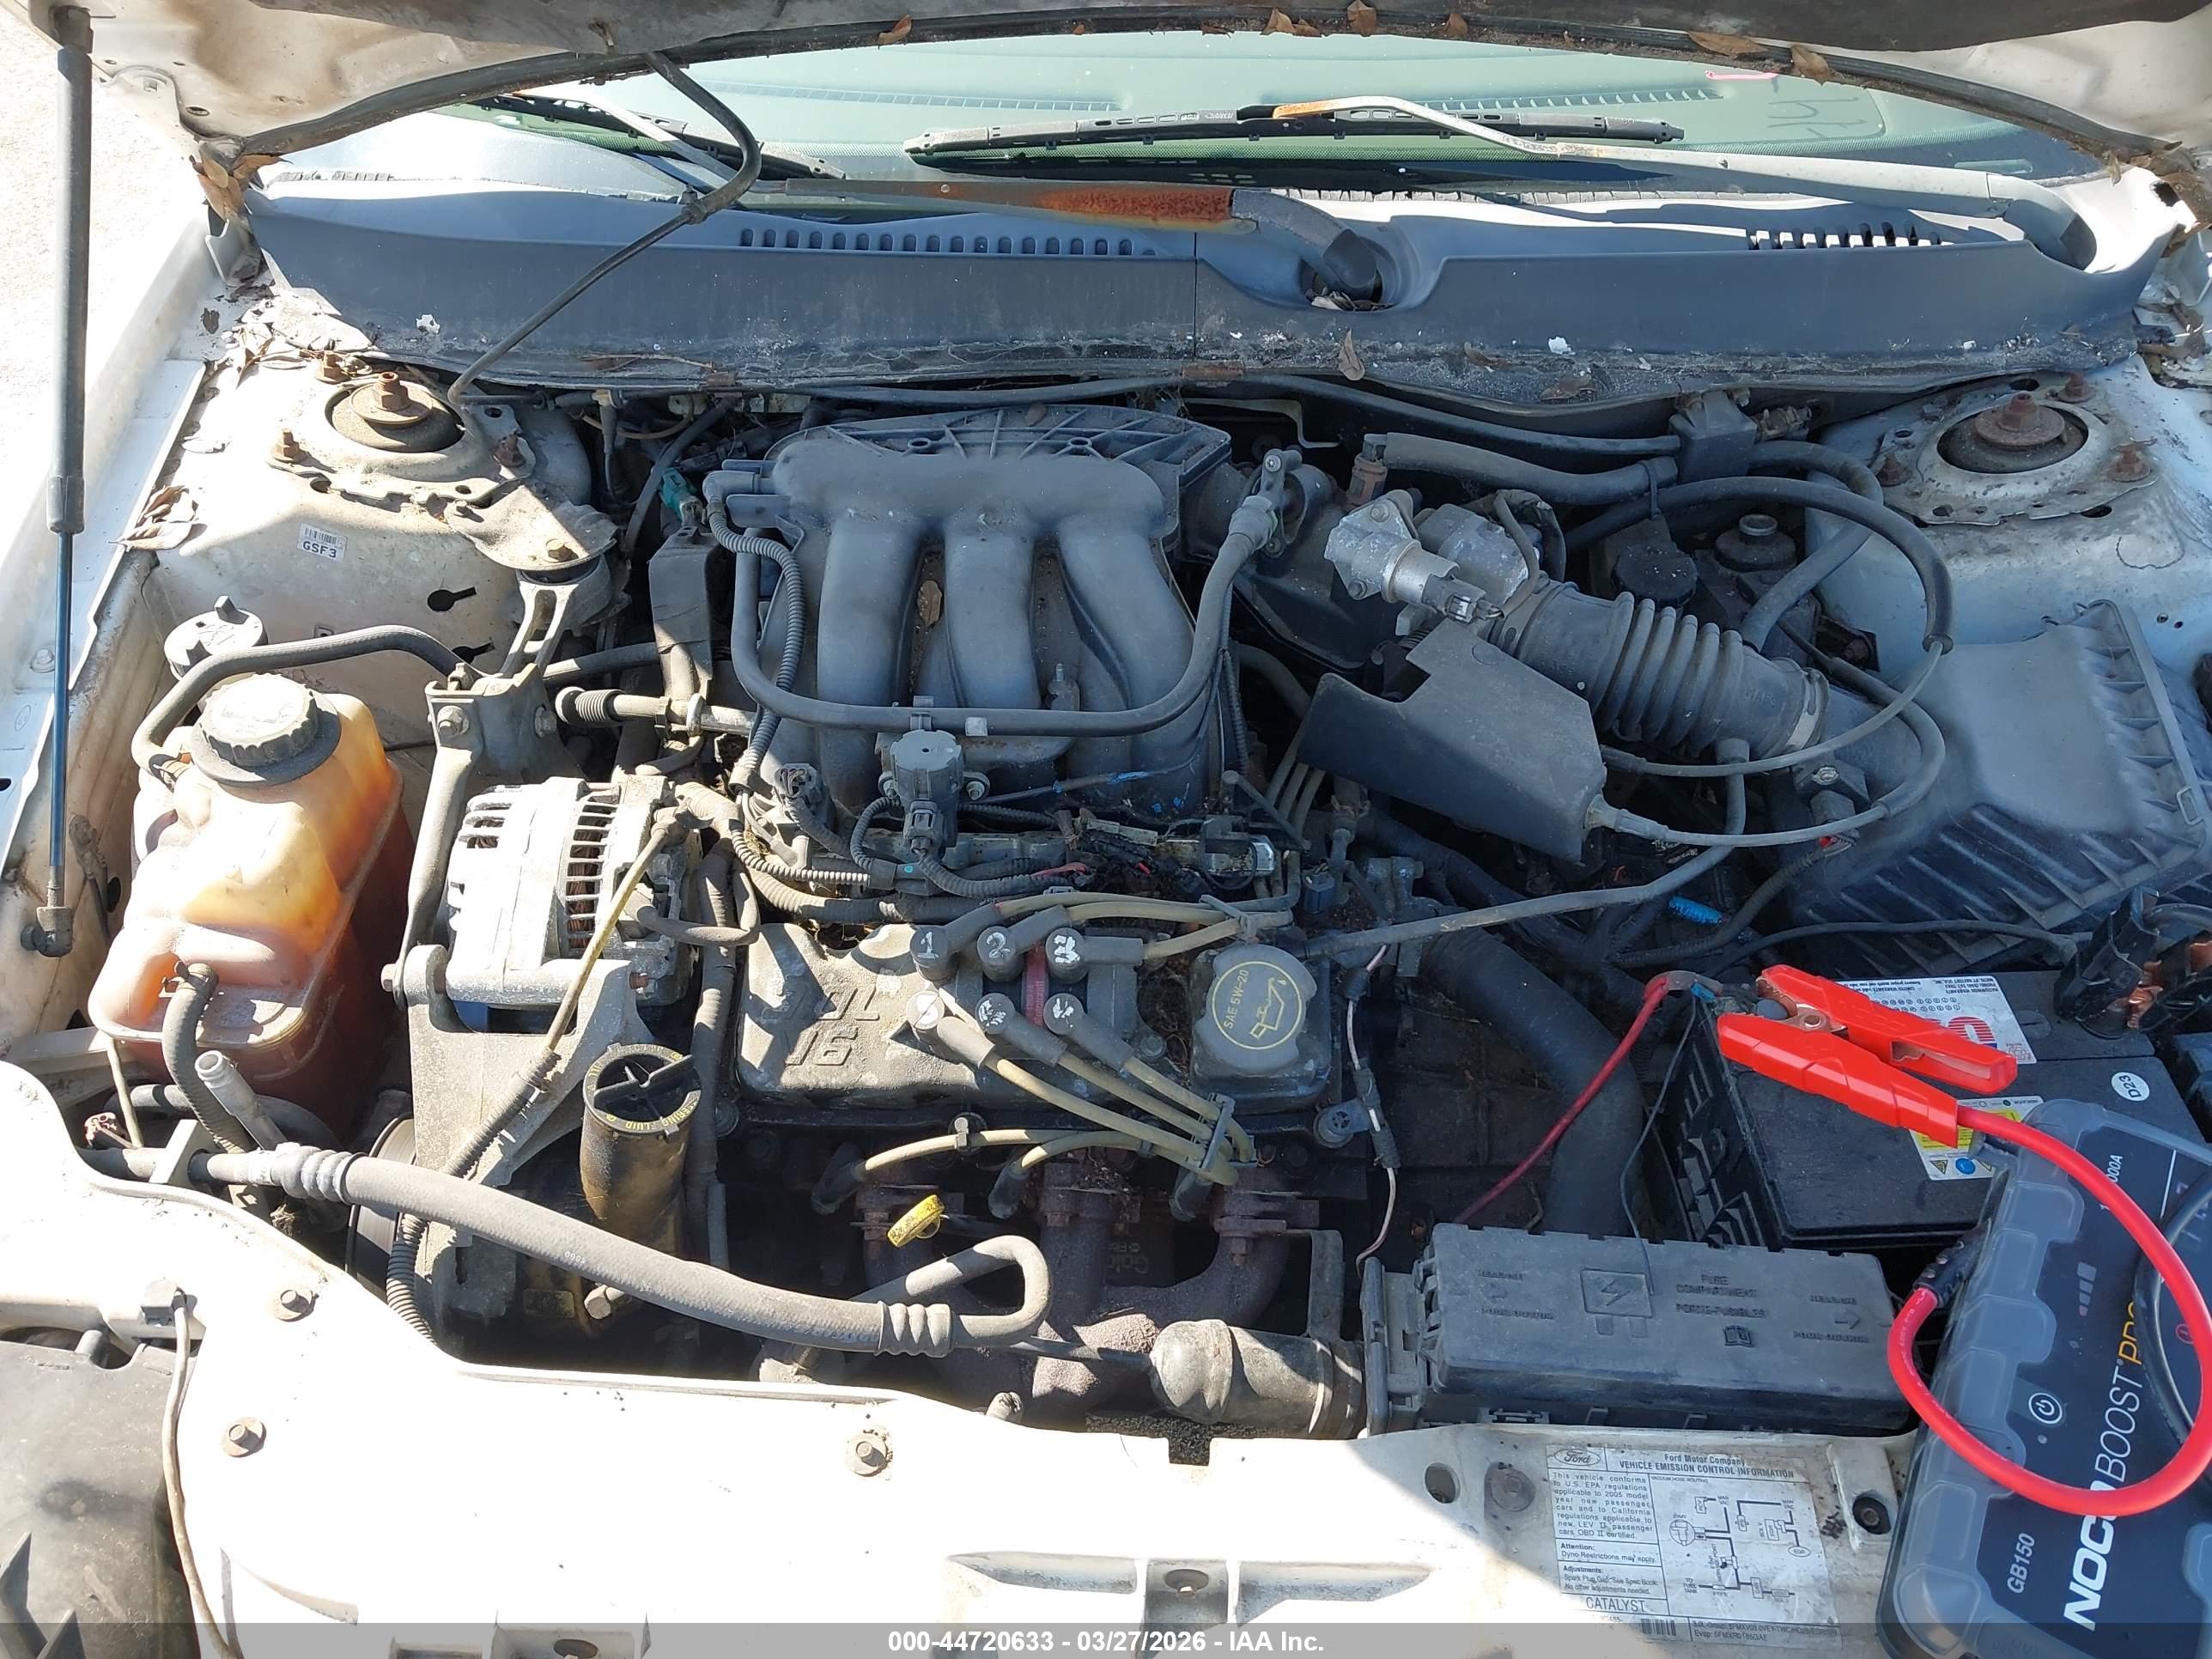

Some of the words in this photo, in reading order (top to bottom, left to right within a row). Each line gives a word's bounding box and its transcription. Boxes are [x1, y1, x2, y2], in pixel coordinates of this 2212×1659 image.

[302, 540, 337, 558] GSF3
[1224, 1006, 1238, 1029] SAE
[1231, 969, 1249, 1005] 5W-20
[2119, 1075, 2142, 1098] D23
[2094, 1365, 2143, 1483] BOOST
[1664, 1454, 1682, 1462] Ford
[1685, 1454, 1707, 1463] Motor
[1709, 1455, 1746, 1468] Company
[1620, 1460, 1653, 1470] VEHICLE
[1655, 1462, 1695, 1473] EMISSION
[1697, 1464, 1735, 1475] CONTROL
[1737, 1467, 1795, 1478] INFORMATION
[1554, 1487, 1591, 1496] applicable
[1605, 1499, 1650, 1509] passenger
[1611, 1506, 1650, 1516] California
[1602, 1514, 1641, 1523] applicable
[1581, 1552, 1620, 1560] Restrictions
[1563, 1565, 1603, 1574] Adjustments:
[2007, 1533, 2035, 1595] GB150
[1585, 1597, 1645, 1613] CATALYST
